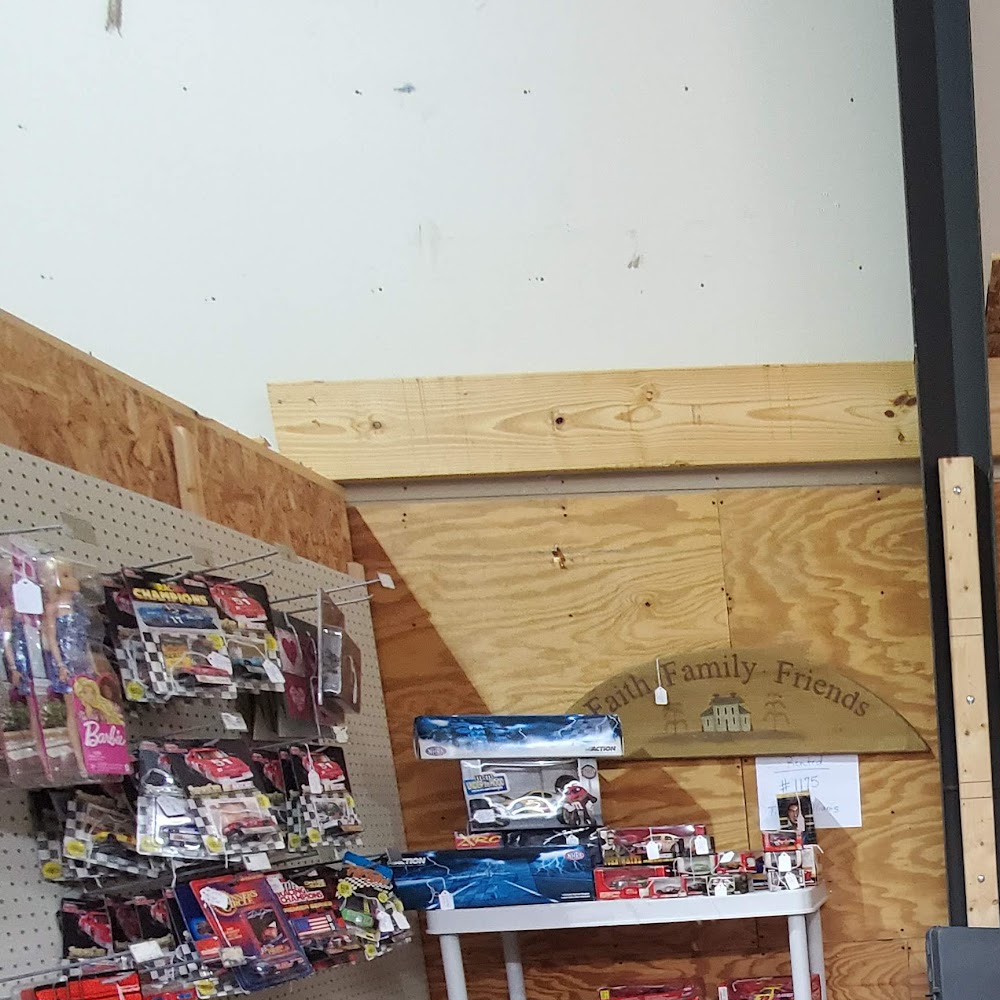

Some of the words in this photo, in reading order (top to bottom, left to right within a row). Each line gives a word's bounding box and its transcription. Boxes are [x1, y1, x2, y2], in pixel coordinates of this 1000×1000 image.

[132, 587, 208, 605] CHAMPIONS
[583, 674, 652, 716] Faith
[660, 653, 757, 687] Family
[774, 660, 870, 717] Friends
[83, 720, 126, 747] Barbie
